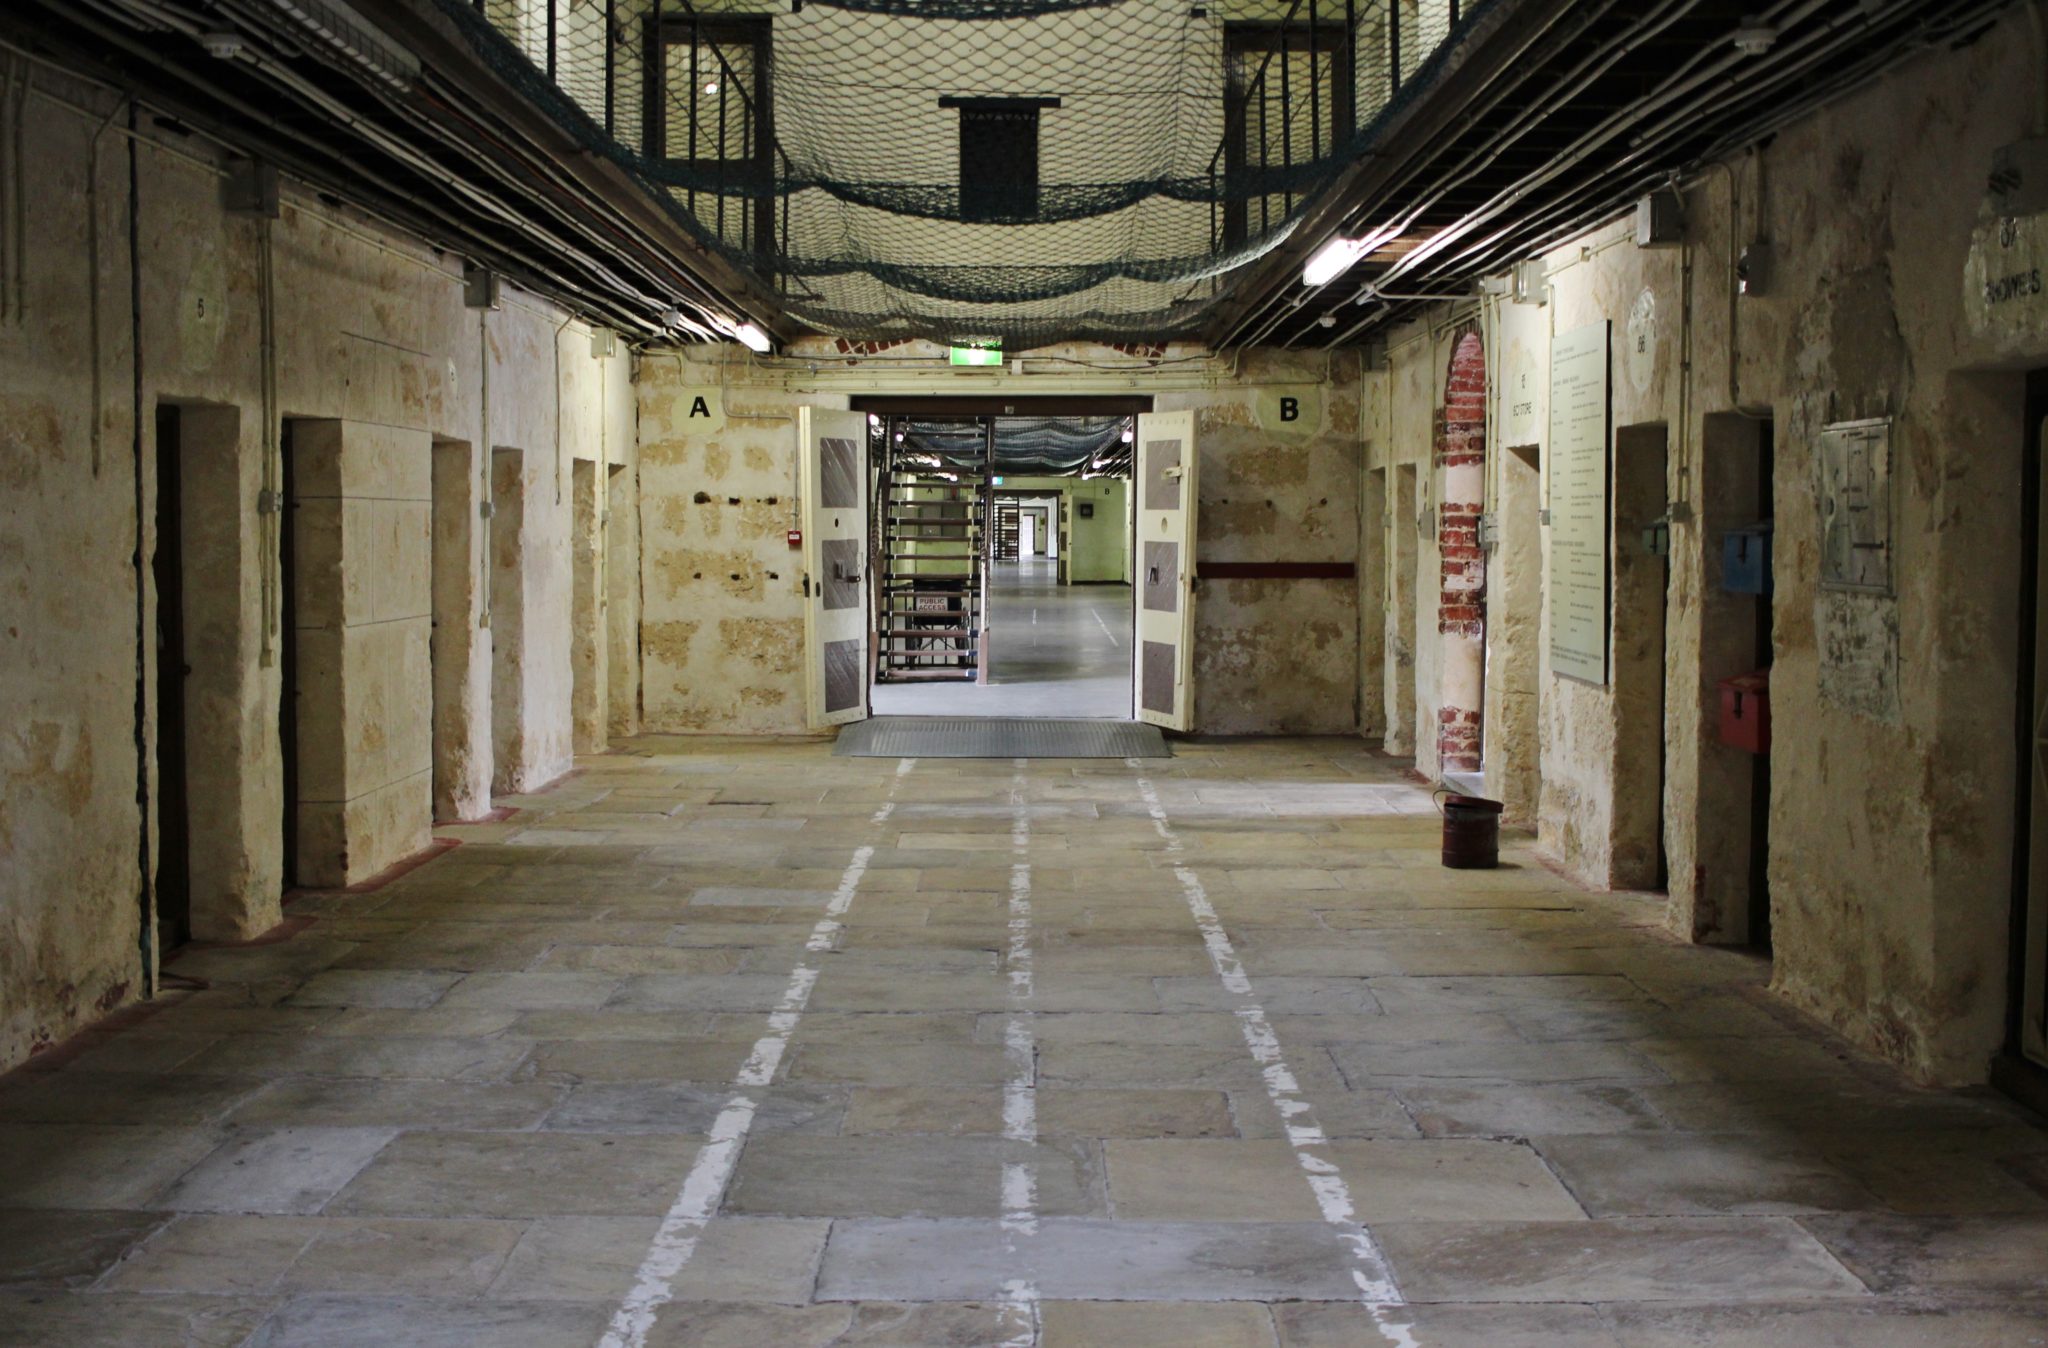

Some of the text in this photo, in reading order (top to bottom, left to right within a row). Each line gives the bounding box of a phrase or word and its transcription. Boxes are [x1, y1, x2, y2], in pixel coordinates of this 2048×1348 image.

[197, 298, 204, 319] 5
[689, 396, 711, 418] A
[1280, 397, 1299, 421] B
